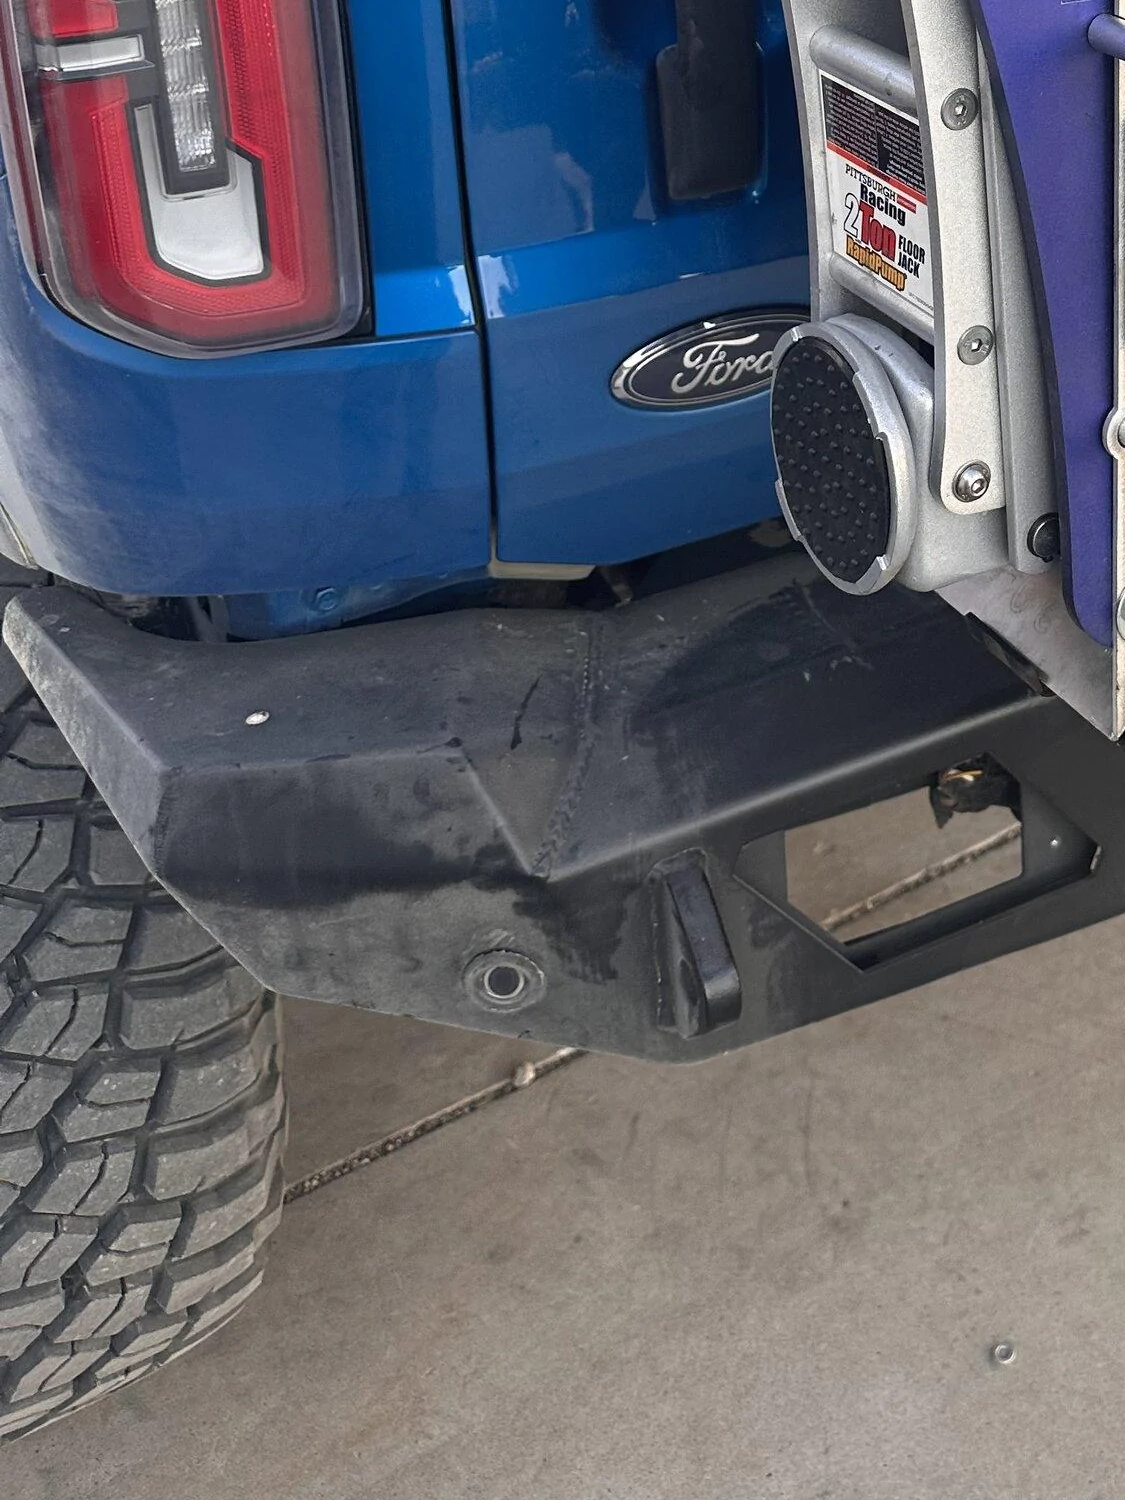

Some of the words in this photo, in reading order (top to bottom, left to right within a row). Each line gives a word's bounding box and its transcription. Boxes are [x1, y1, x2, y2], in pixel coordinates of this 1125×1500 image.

[845, 164, 896, 202] PITTSBURGH
[860, 183, 906, 227] Racing
[844, 192, 860, 238] 2
[859, 199, 896, 262] Ton
[845, 234, 907, 292] RapidPump
[897, 252, 920, 279] JACK
[898, 234, 925, 265] FLOOR
